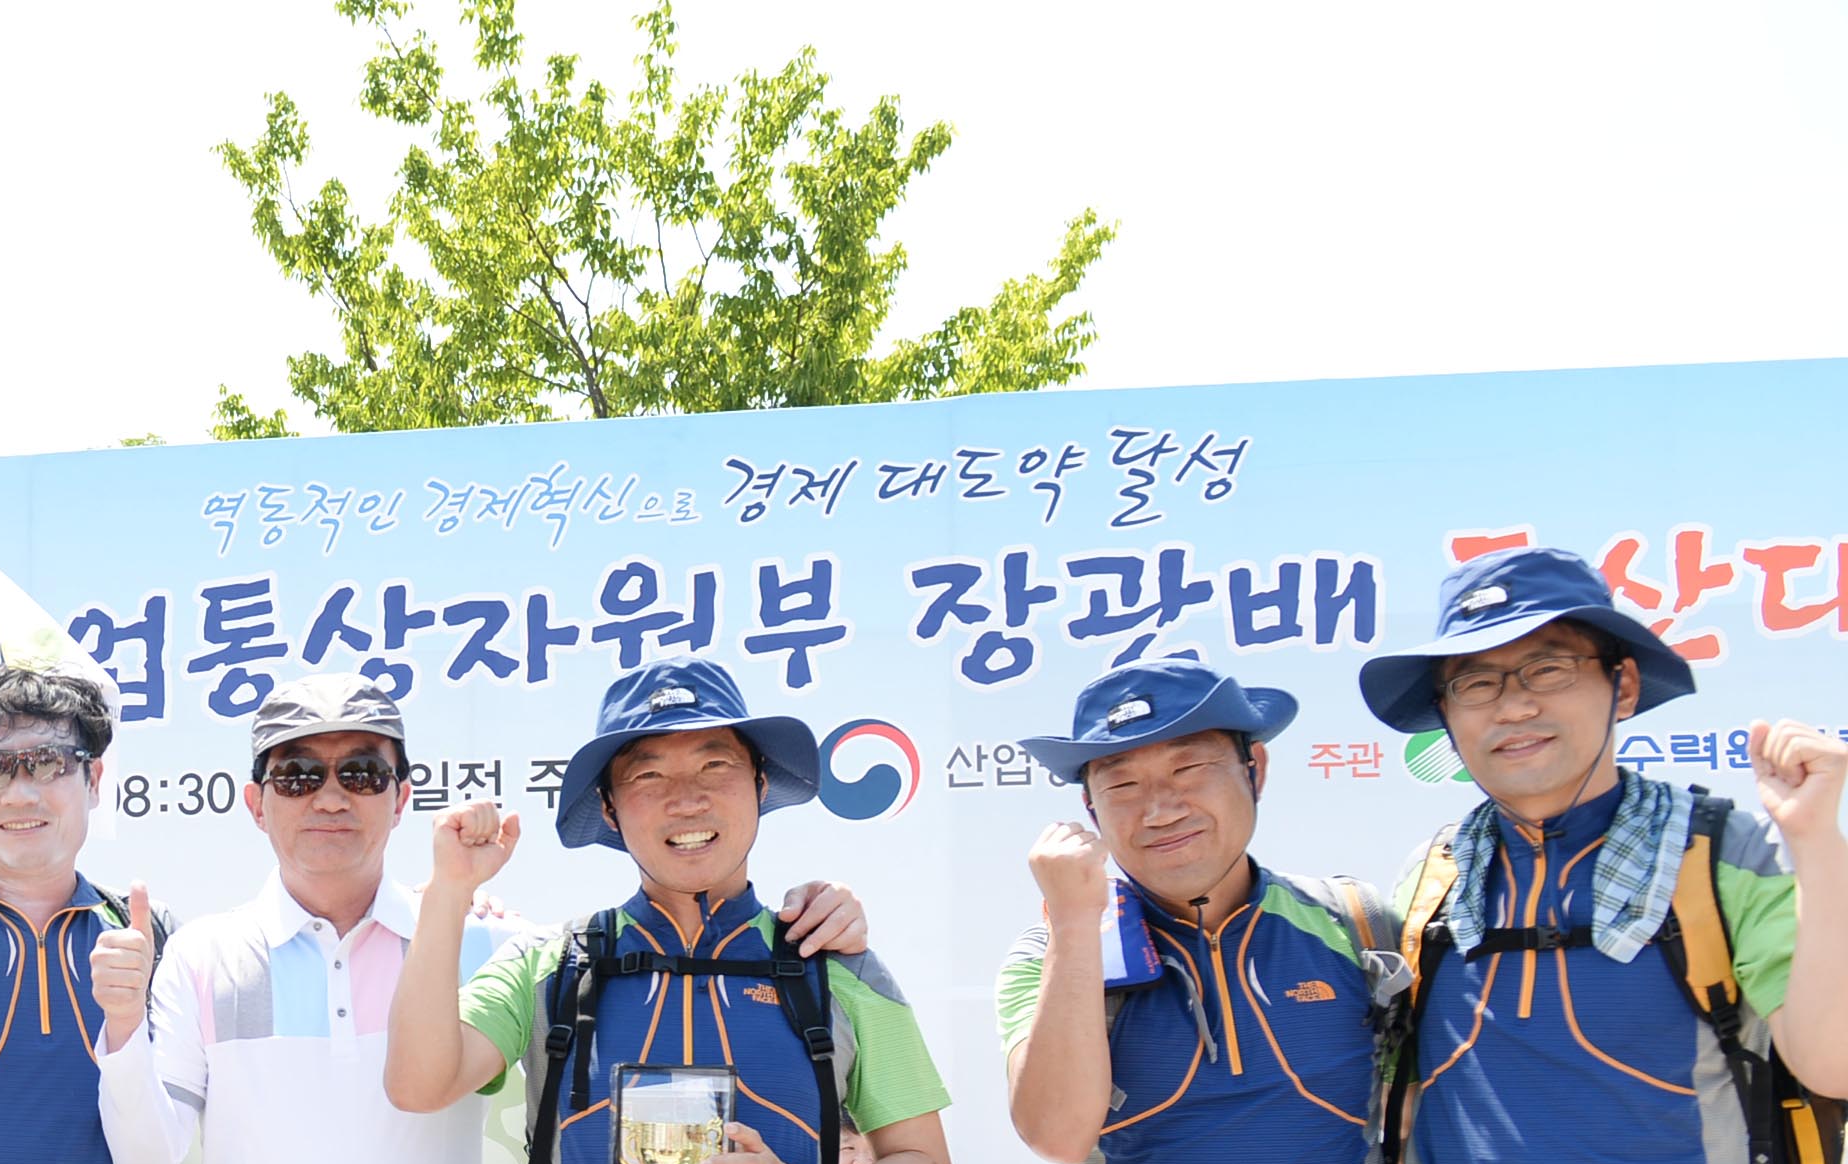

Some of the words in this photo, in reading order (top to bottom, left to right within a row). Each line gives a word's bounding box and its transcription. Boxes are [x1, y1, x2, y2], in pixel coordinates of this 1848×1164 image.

[203, 485, 403, 555] 역동적인
[724, 458, 858, 523] 경제
[1109, 428, 1249, 528] 달성
[911, 549, 1376, 685] 장관배
[1451, 530, 1848, 661] 산대
[946, 744, 1068, 788] 산업
[1308, 742, 1384, 779] 주관
[116, 773, 235, 817] 8:30
